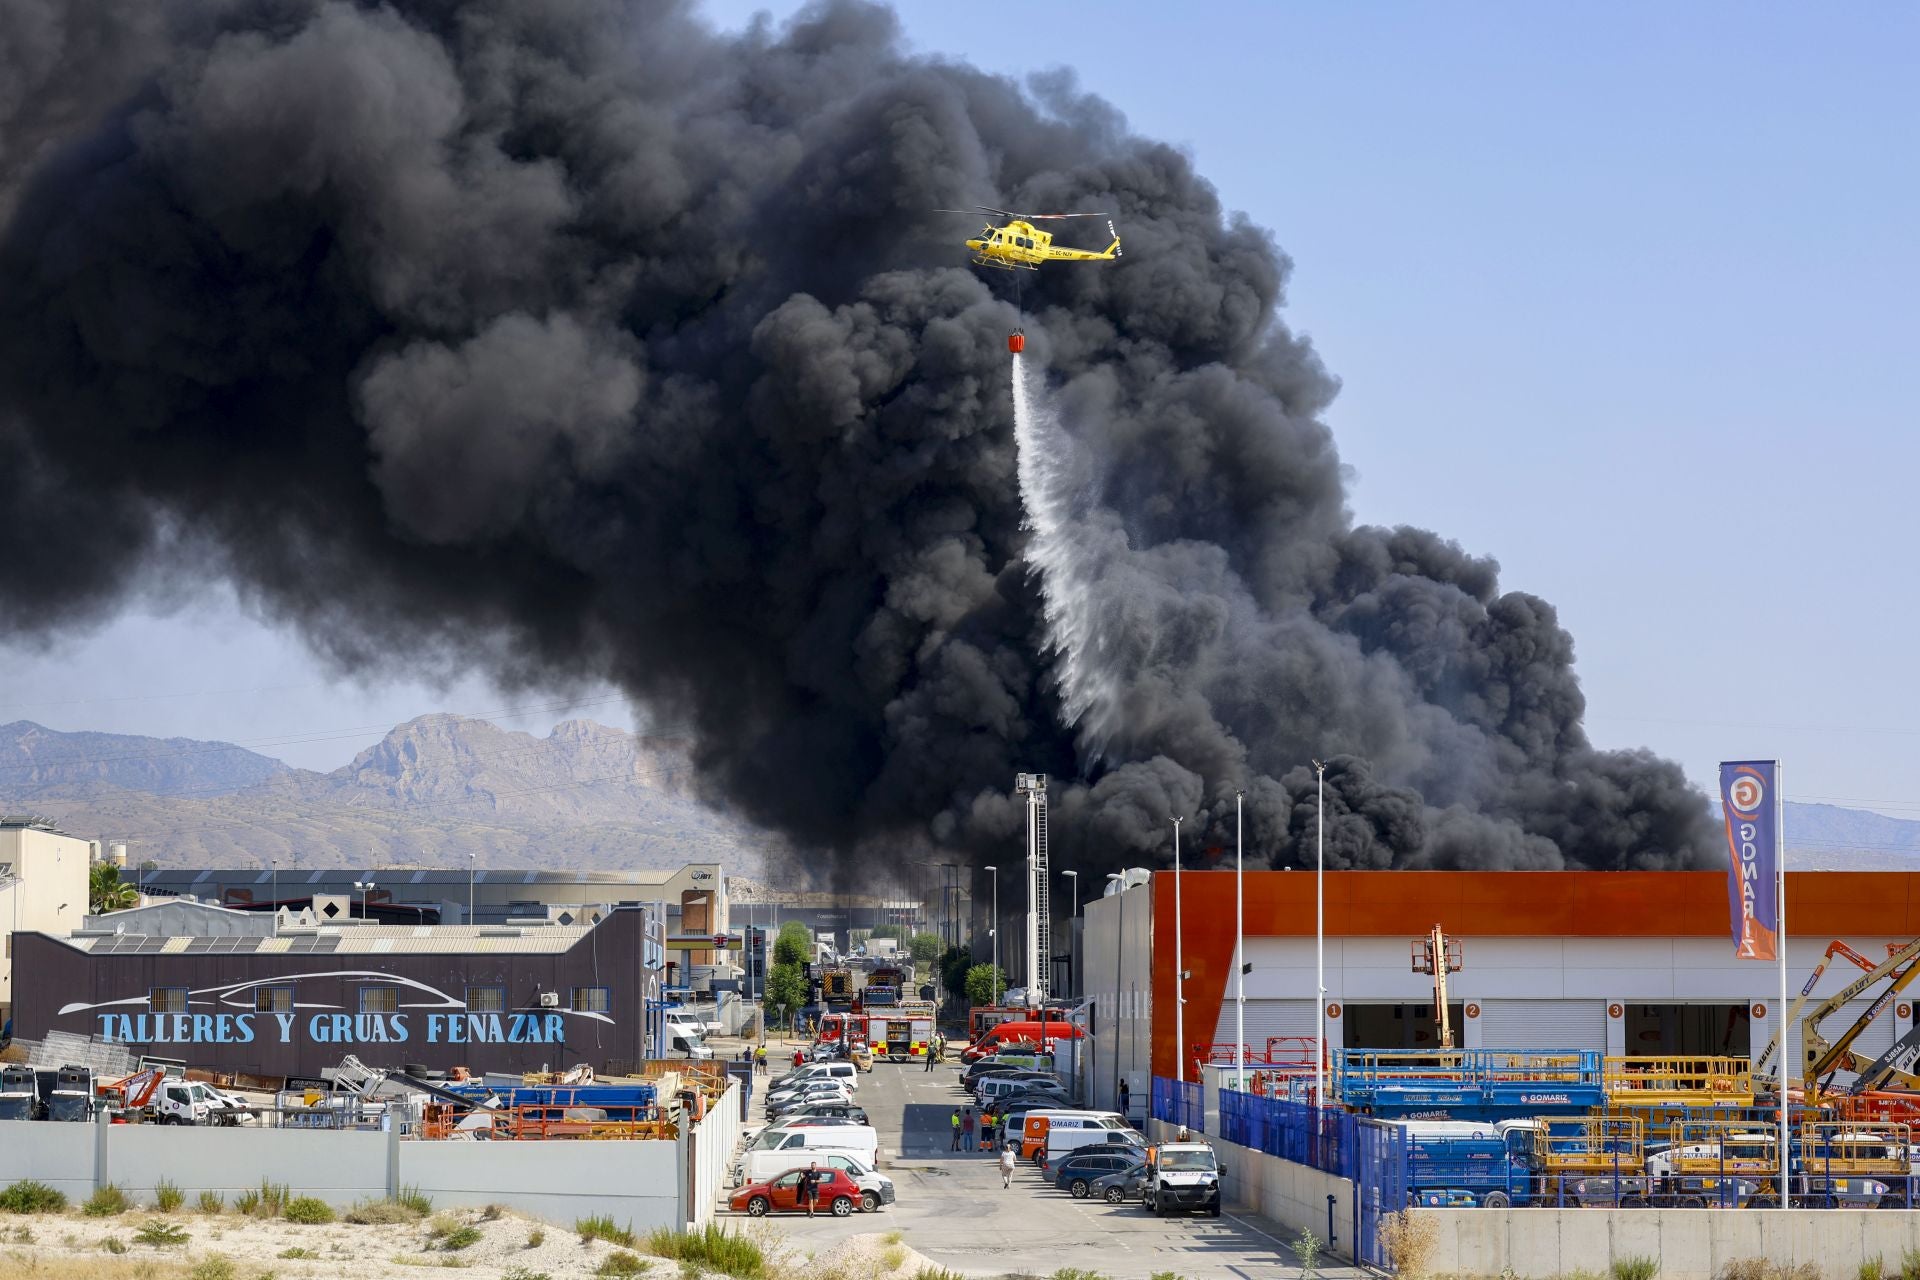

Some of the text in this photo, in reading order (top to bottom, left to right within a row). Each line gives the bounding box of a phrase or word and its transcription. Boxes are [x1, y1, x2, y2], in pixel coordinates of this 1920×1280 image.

[1331, 1005, 1337, 1015] 1
[1469, 1005, 1476, 1016] 2
[1613, 1005, 1619, 1015] 3
[1755, 1006, 1762, 1015] 4
[1901, 1006, 1907, 1015] 5
[98, 1013, 565, 1043] TALLERES Y GRUAS FENAZAR
[1410, 1110, 1448, 1119] GOMARIZ
[1047, 1120, 1079, 1128] GOMARIZ
